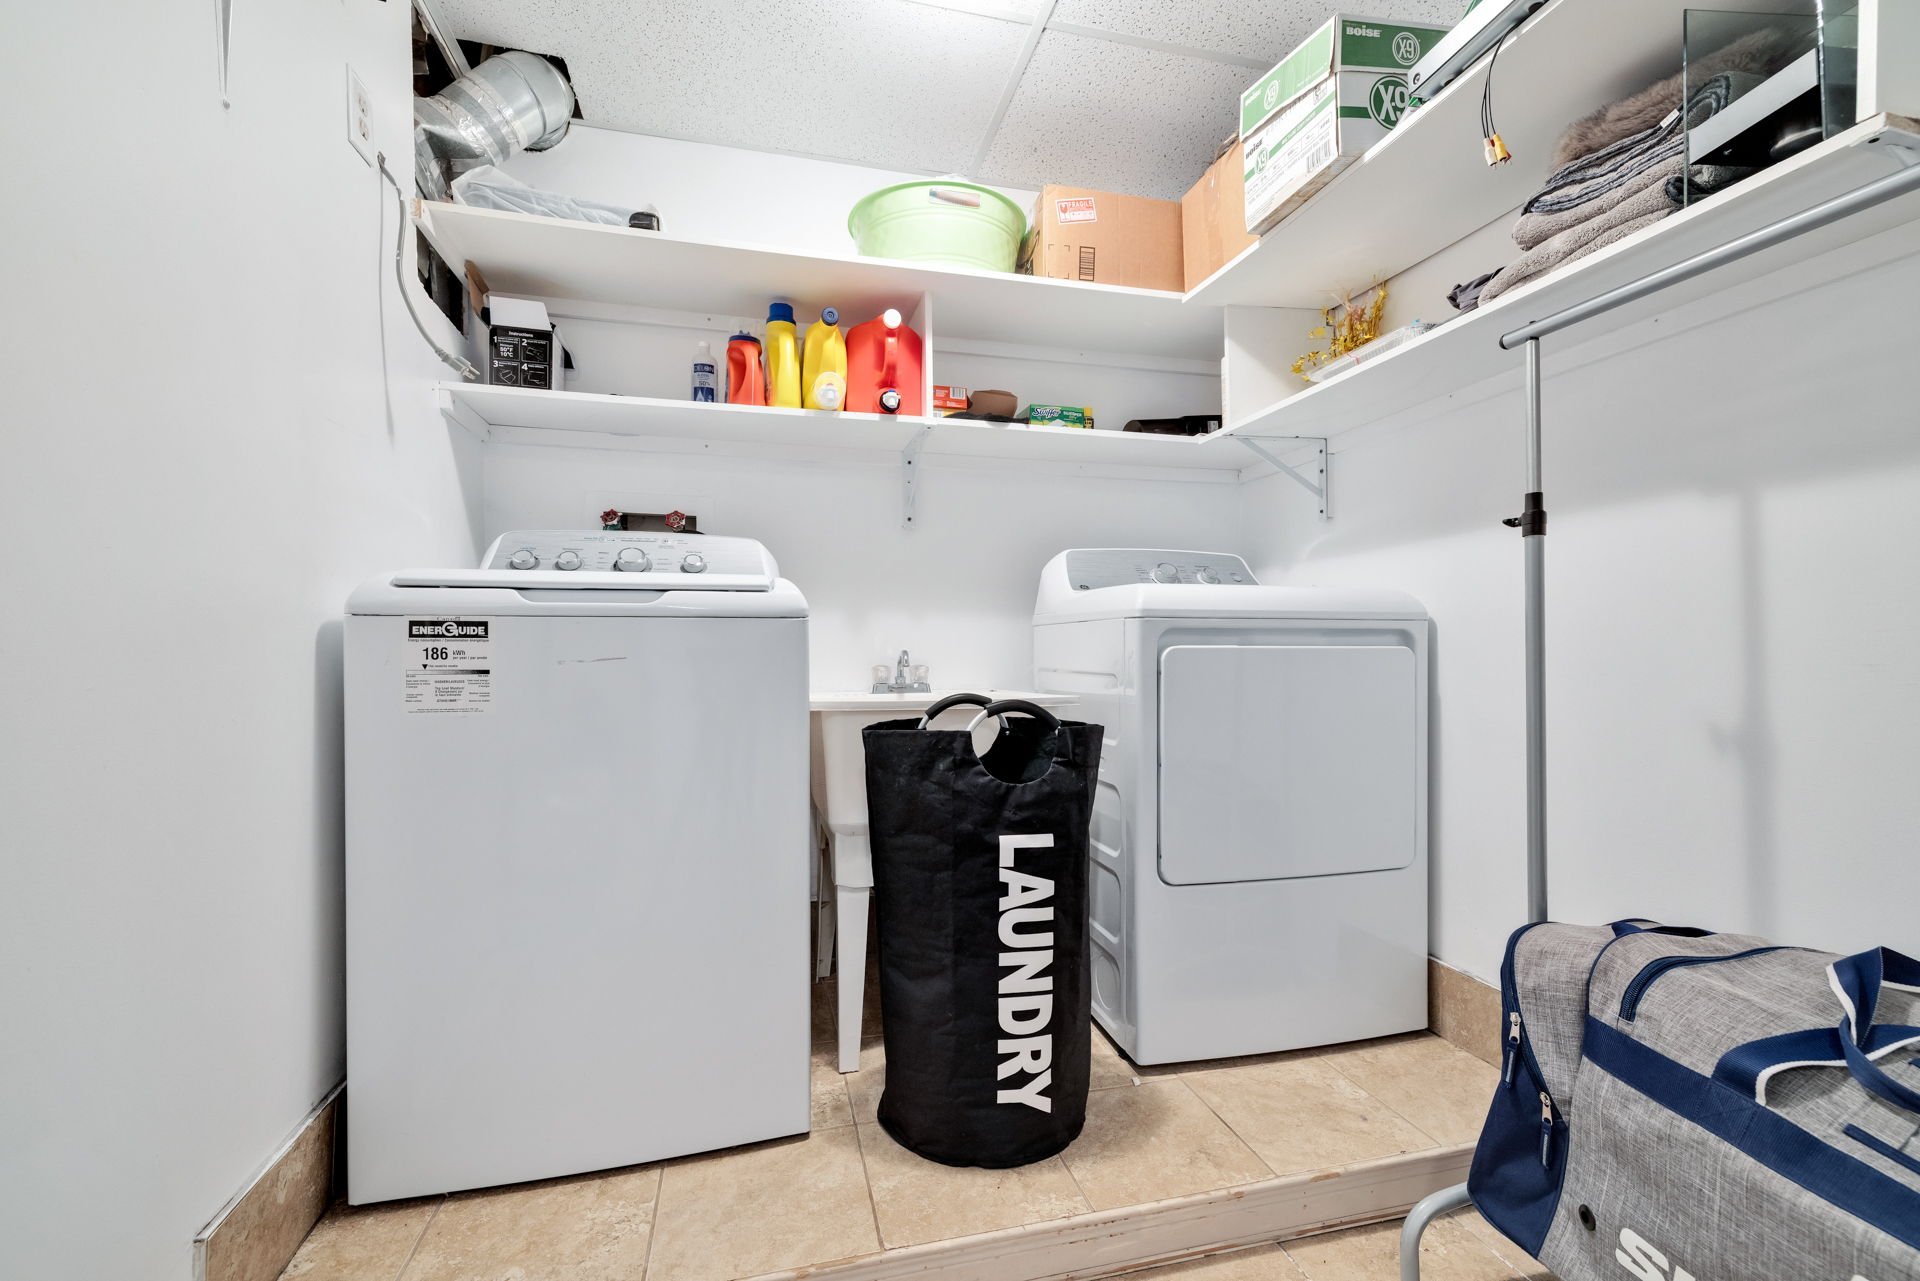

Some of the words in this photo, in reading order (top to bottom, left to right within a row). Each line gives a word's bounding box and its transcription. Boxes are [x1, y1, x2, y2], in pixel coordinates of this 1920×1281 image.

[521, 338, 528, 346] 2
[493, 360, 499, 368] 3
[521, 363, 529, 371] 4
[1032, 407, 1061, 419] Swiffer
[412, 621, 486, 637] ENERGUIDE
[422, 646, 449, 661] 186
[997, 832, 1055, 1114] LAUNDRY
